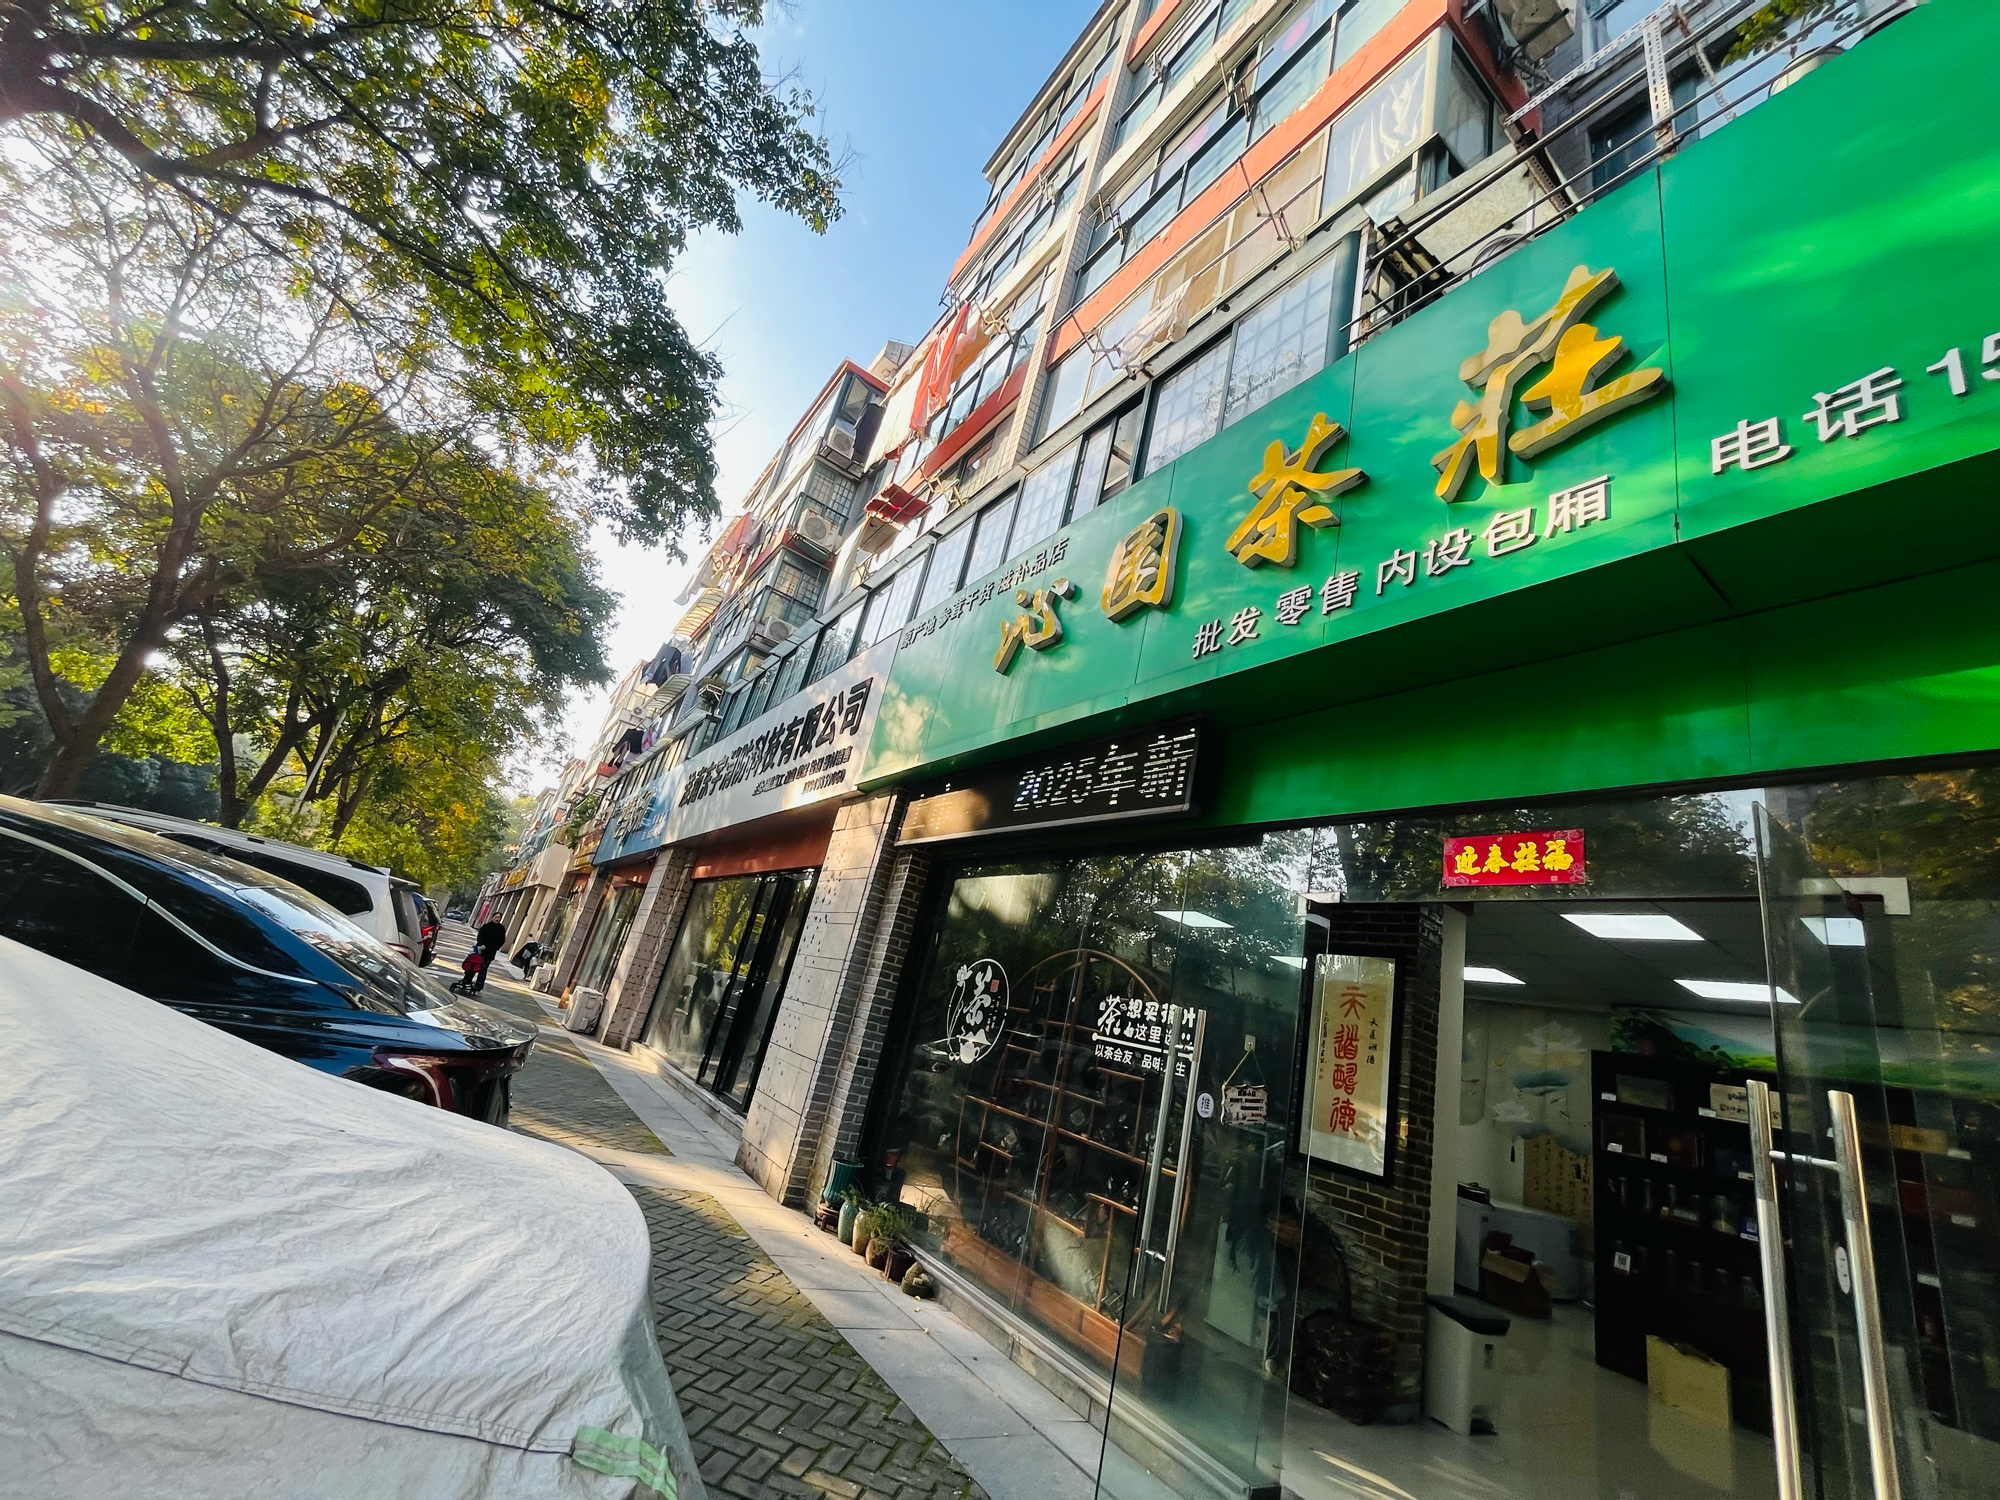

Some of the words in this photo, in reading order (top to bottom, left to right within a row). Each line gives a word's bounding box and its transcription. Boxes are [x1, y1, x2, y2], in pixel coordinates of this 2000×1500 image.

[1710, 366, 1903, 476] 电话
[1192, 606, 1262, 660] 批发
[1274, 570, 1360, 626] 零售
[1375, 473, 1611, 596] 内设包厢
[1454, 839, 1574, 875] 迎春接福
[1094, 1043, 1134, 1065] 以茶会友
[1141, 1053, 1187, 1077] 品味生
